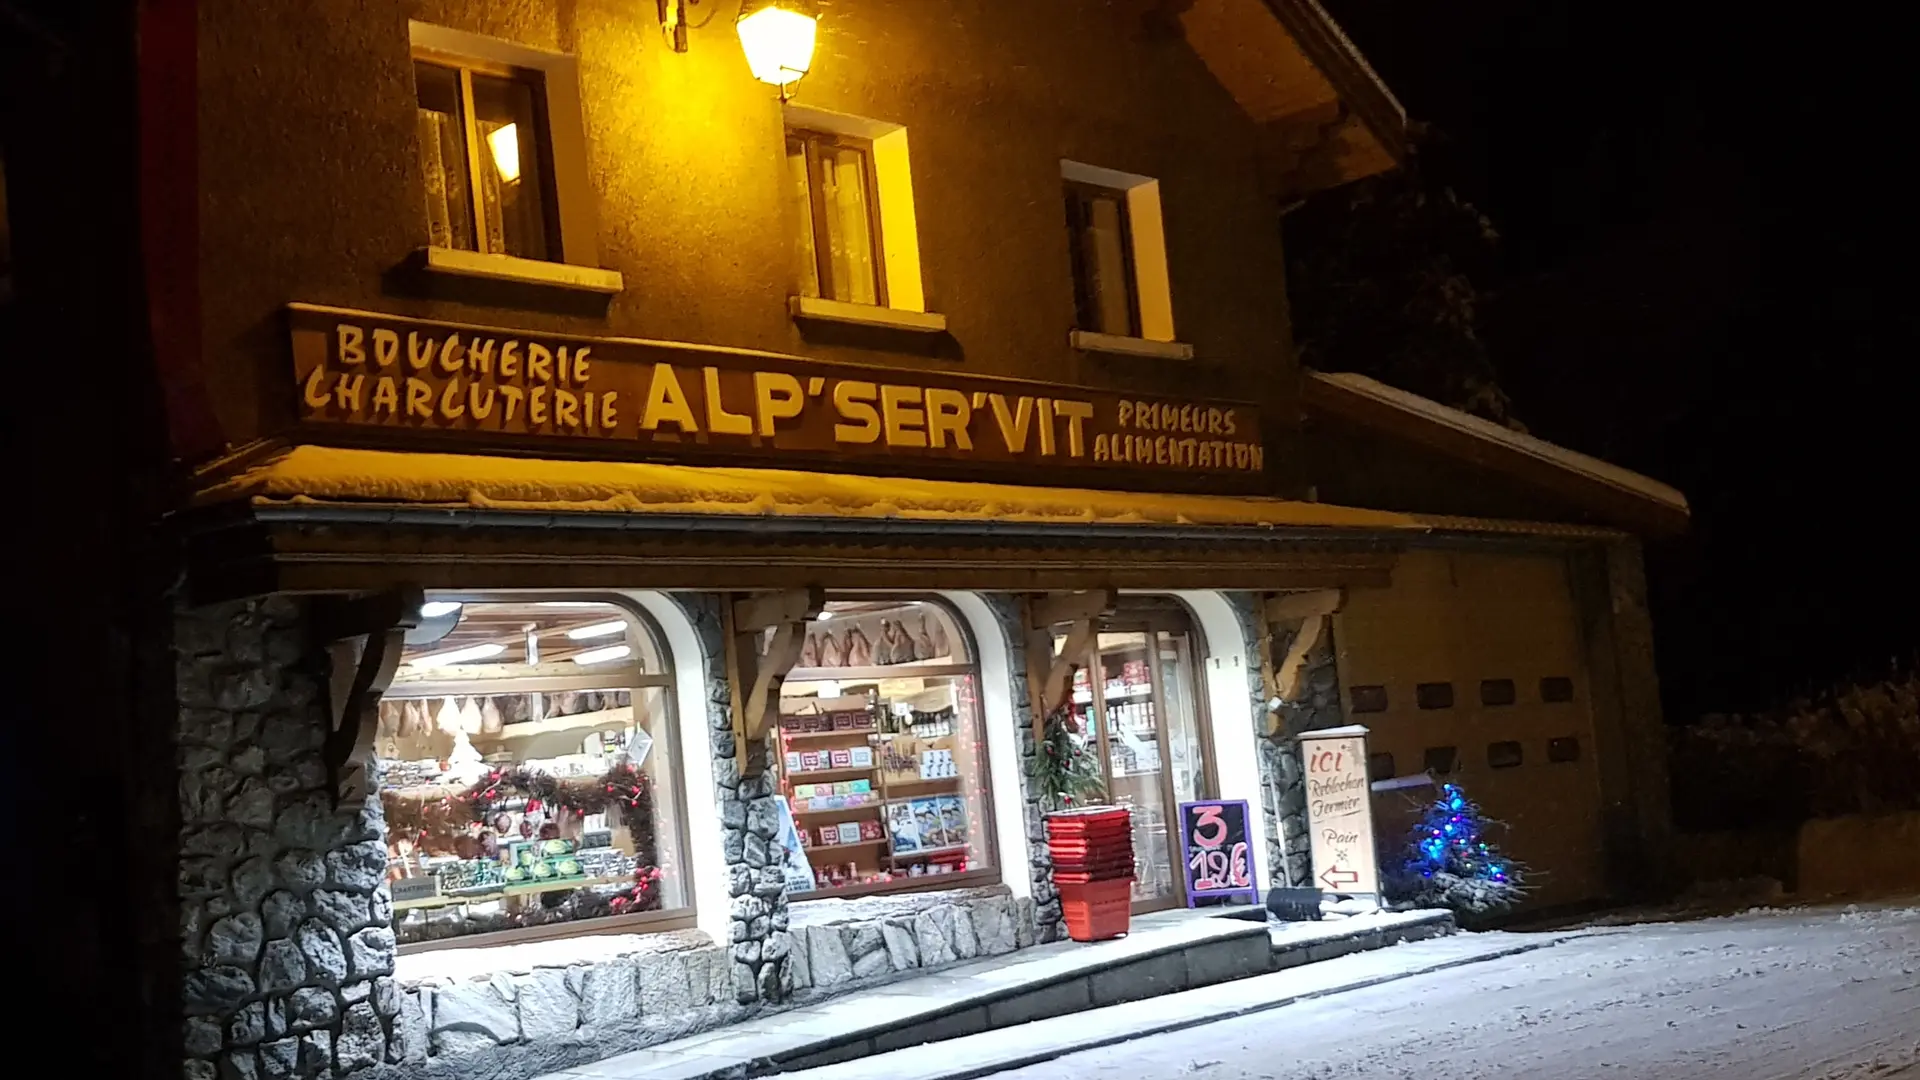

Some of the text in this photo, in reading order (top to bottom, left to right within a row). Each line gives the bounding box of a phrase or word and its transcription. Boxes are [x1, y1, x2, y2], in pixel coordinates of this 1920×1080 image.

[336, 323, 592, 383] BOUCHERIE
[303, 363, 618, 429] CHARCUTERIE
[1118, 399, 1236, 436] PRIMEURS
[1093, 434, 1264, 472] ALIMENTATION
[1312, 796, 1361, 817] Fermier
[1192, 805, 1228, 849] 3
[1321, 828, 1358, 845] Pain
